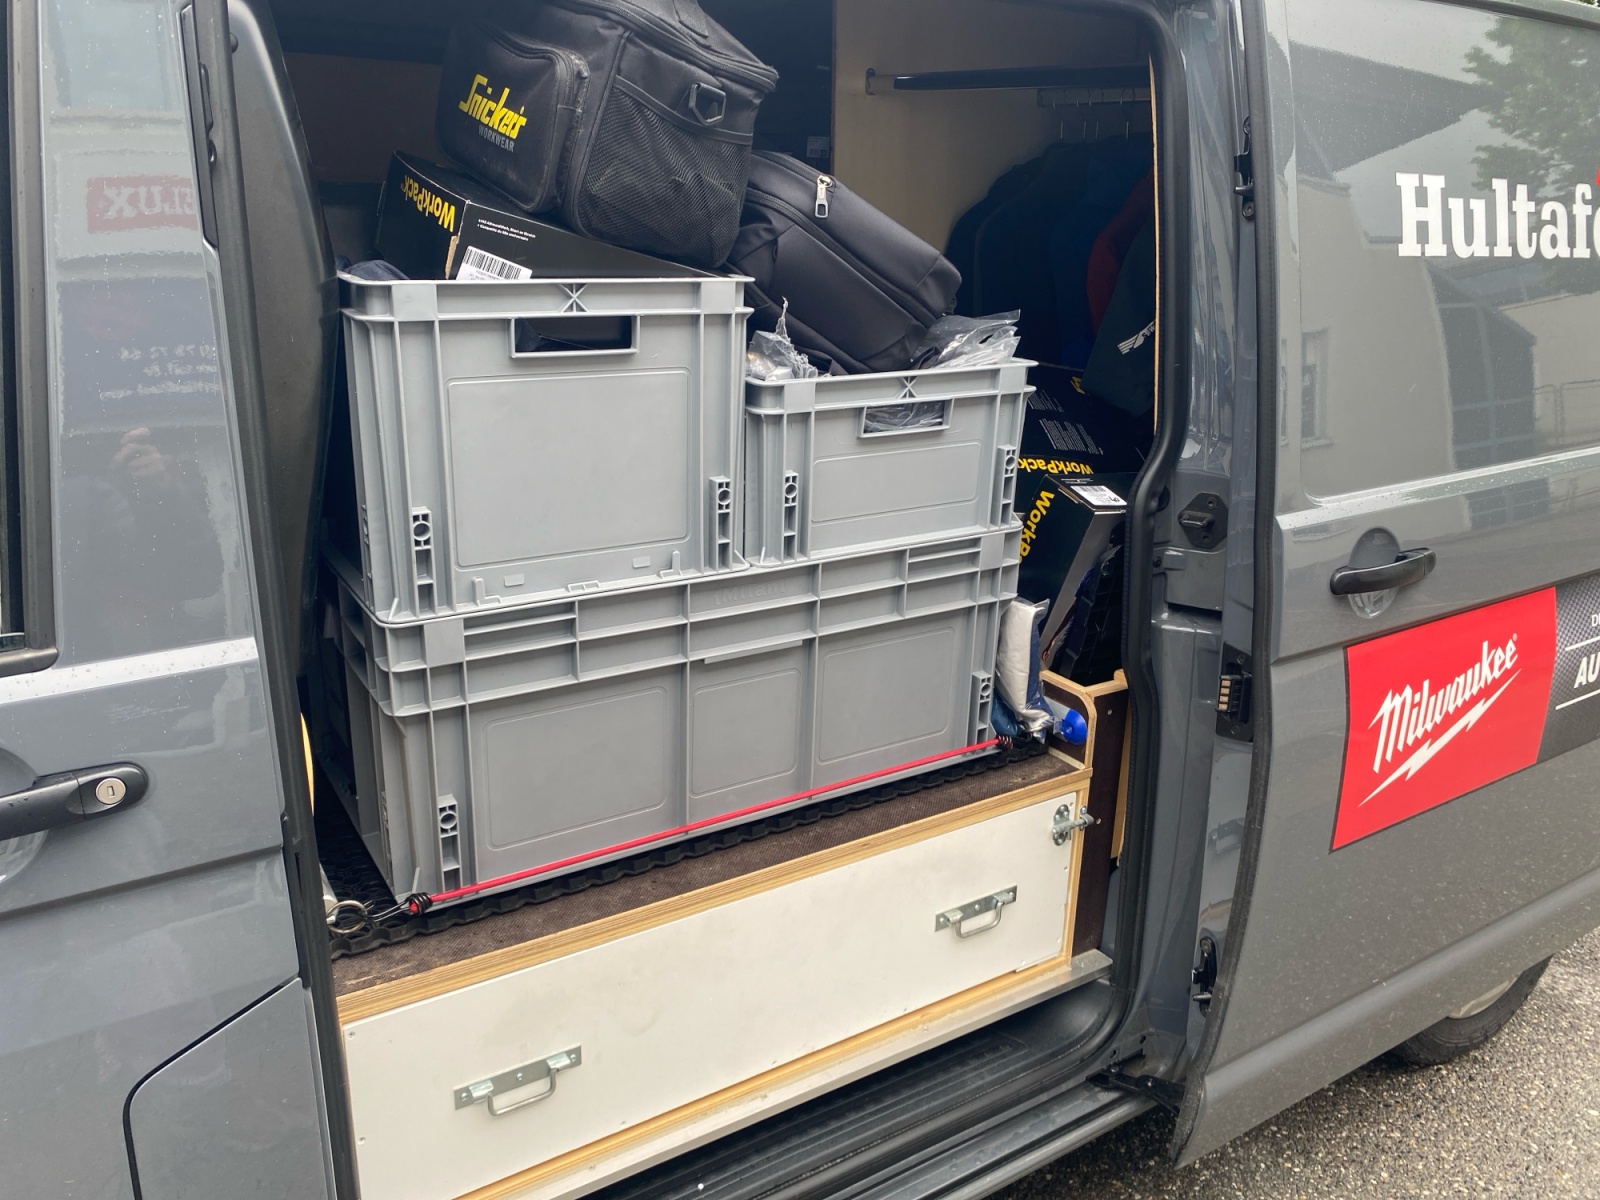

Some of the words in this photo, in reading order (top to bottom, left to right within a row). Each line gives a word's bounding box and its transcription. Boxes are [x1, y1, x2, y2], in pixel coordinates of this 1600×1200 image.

[478, 124, 515, 152] WORKWEAR
[400, 174, 456, 233] WorkPack
[1395, 172, 1600, 259] Hultaf
[1018, 490, 1055, 564] WorkP
[1368, 638, 1519, 774] Milwaukee
